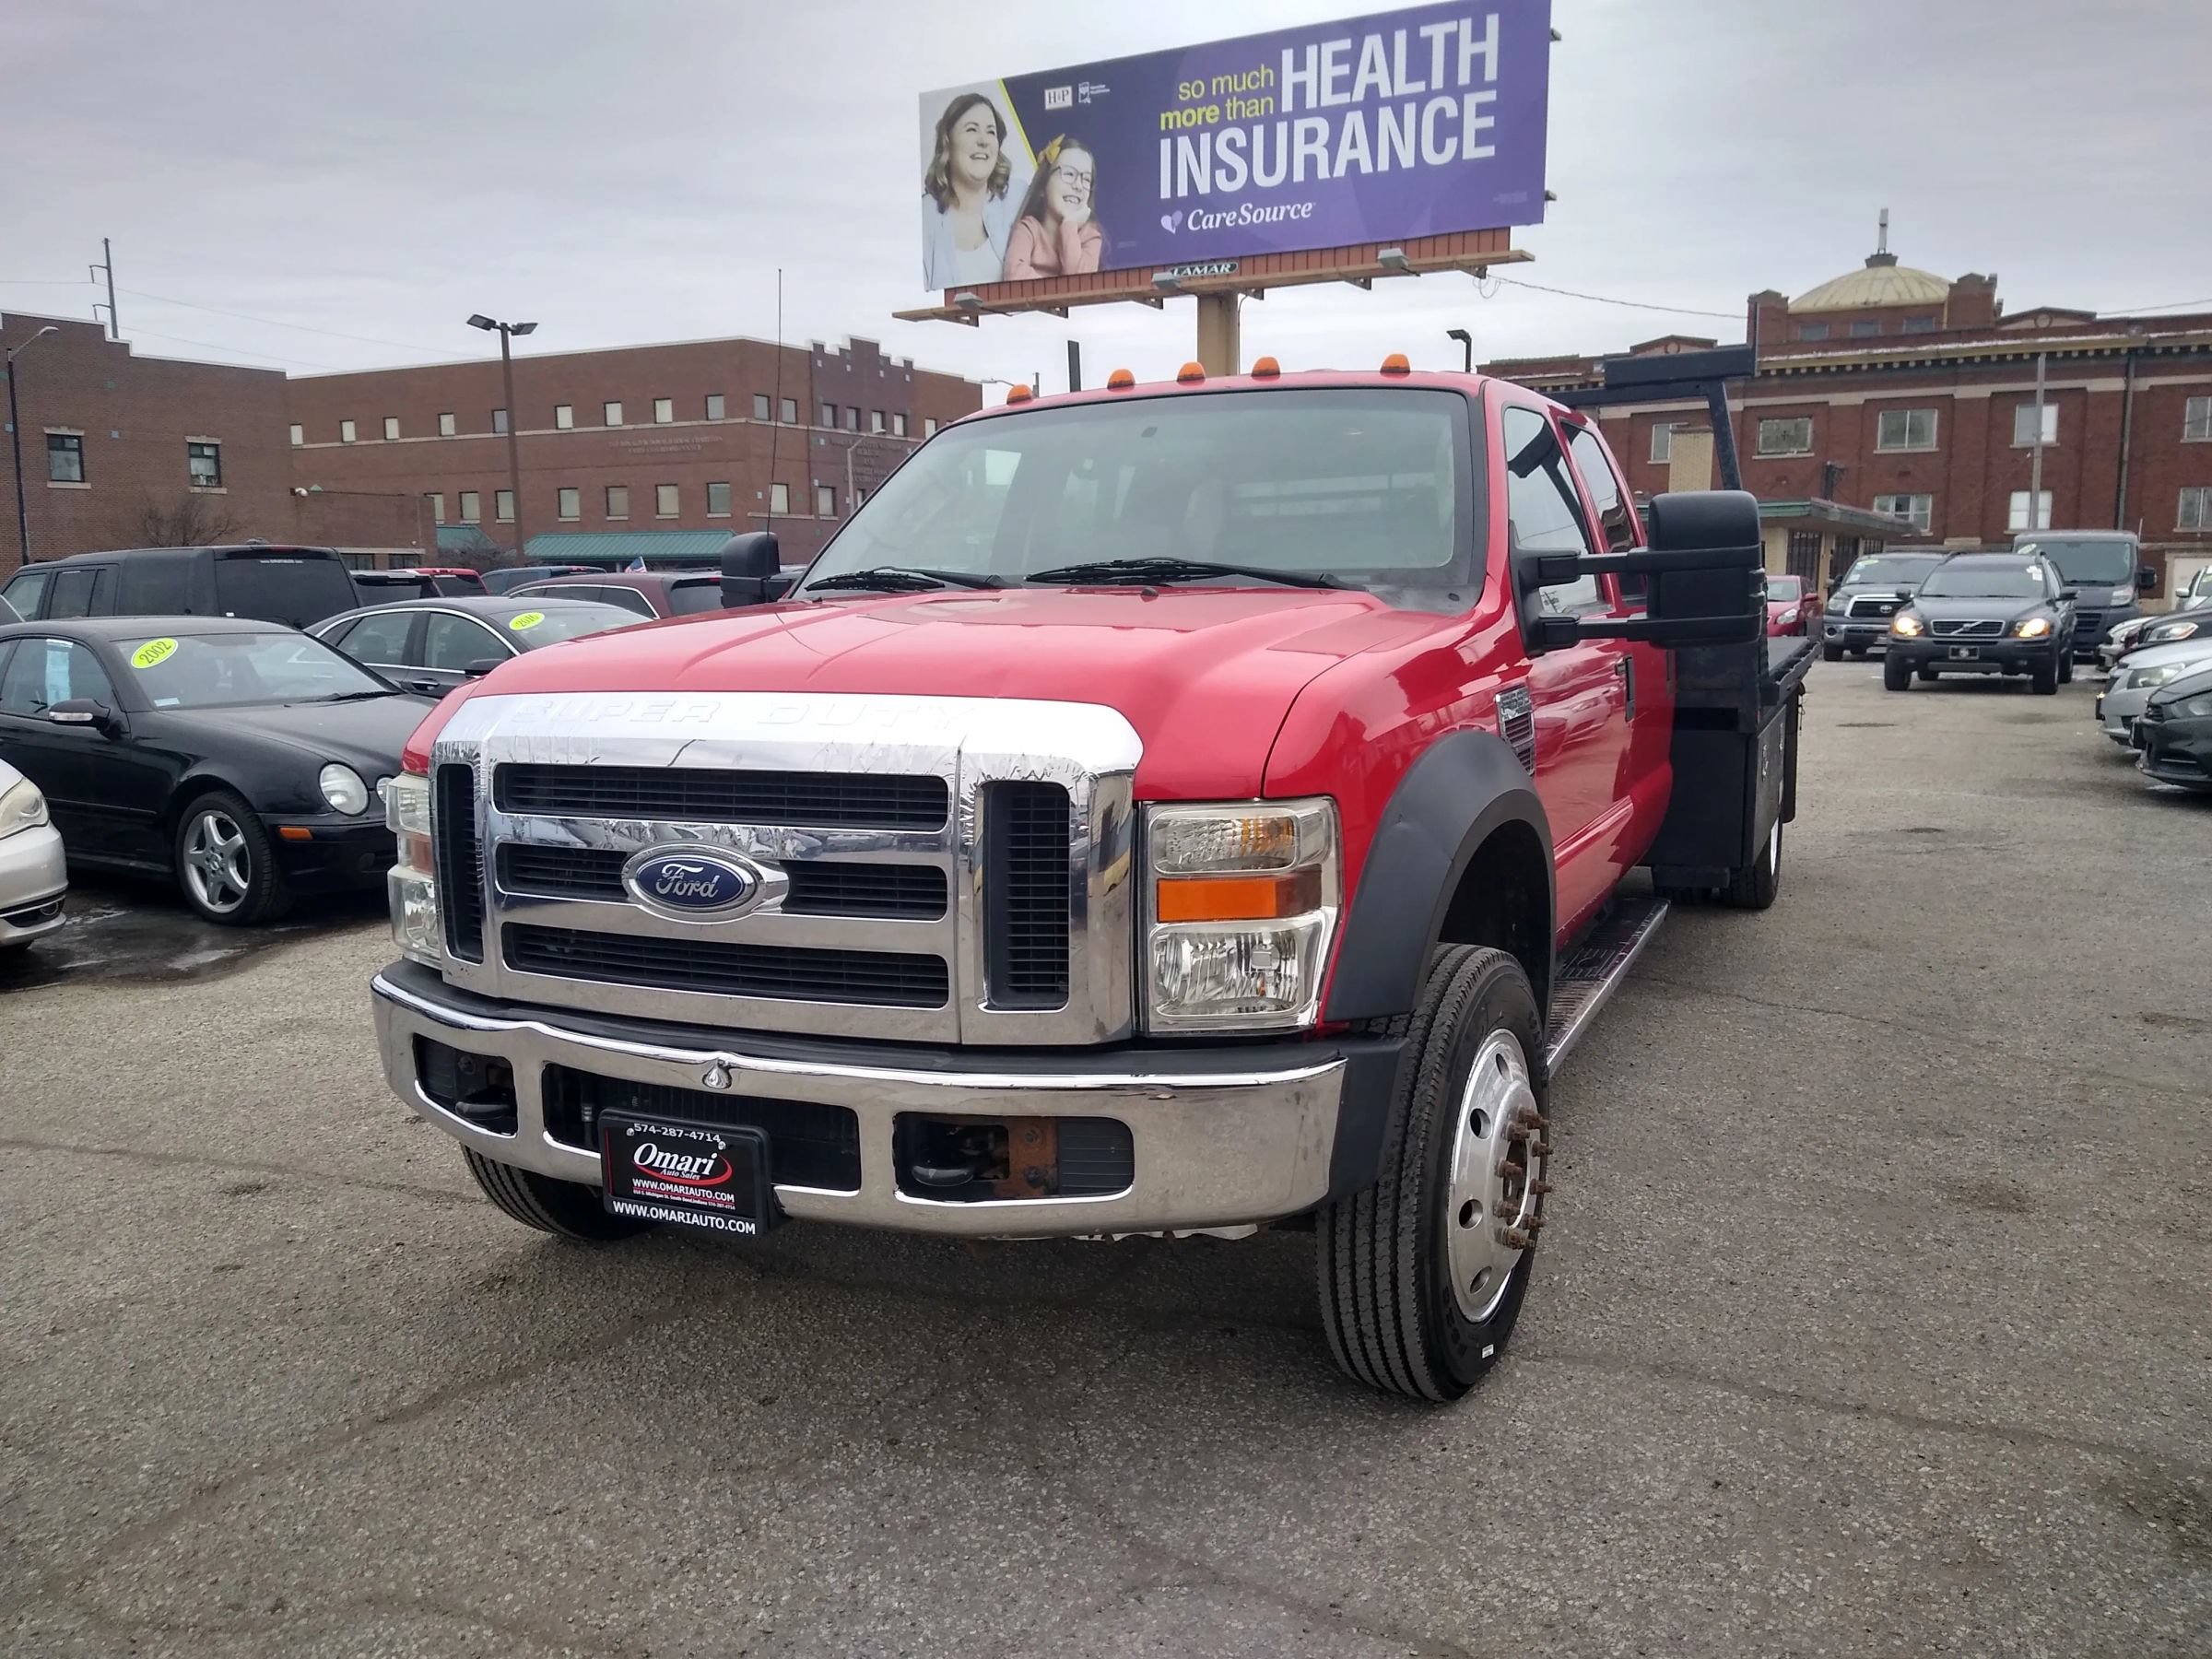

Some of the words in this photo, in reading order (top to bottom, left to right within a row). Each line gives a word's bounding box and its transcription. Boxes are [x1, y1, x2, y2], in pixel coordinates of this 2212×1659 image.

[1281, 13, 1500, 112] HEALTH
[1179, 80, 1205, 100] so
[1212, 64, 1274, 96] much
[1160, 104, 1219, 131] more
[1226, 96, 1274, 121] than
[1160, 89, 1498, 199] INSURANCE
[1187, 202, 1312, 231] CareSource
[1172, 263, 1231, 276] LAMAR
[138, 641, 171, 664] 2002
[512, 700, 723, 724] SUPER
[756, 702, 975, 730] DUTY
[655, 864, 721, 898] Ford
[633, 1124, 722, 1143] 574-287-4714
[633, 1143, 718, 1175] Omari
[632, 1178, 735, 1203] WWW.OMARIAUTO.COM
[660, 1169, 680, 1177] Auto
[680, 1171, 701, 1181] Sales
[613, 1201, 756, 1235] WWW.OMARIAUTO.COM
